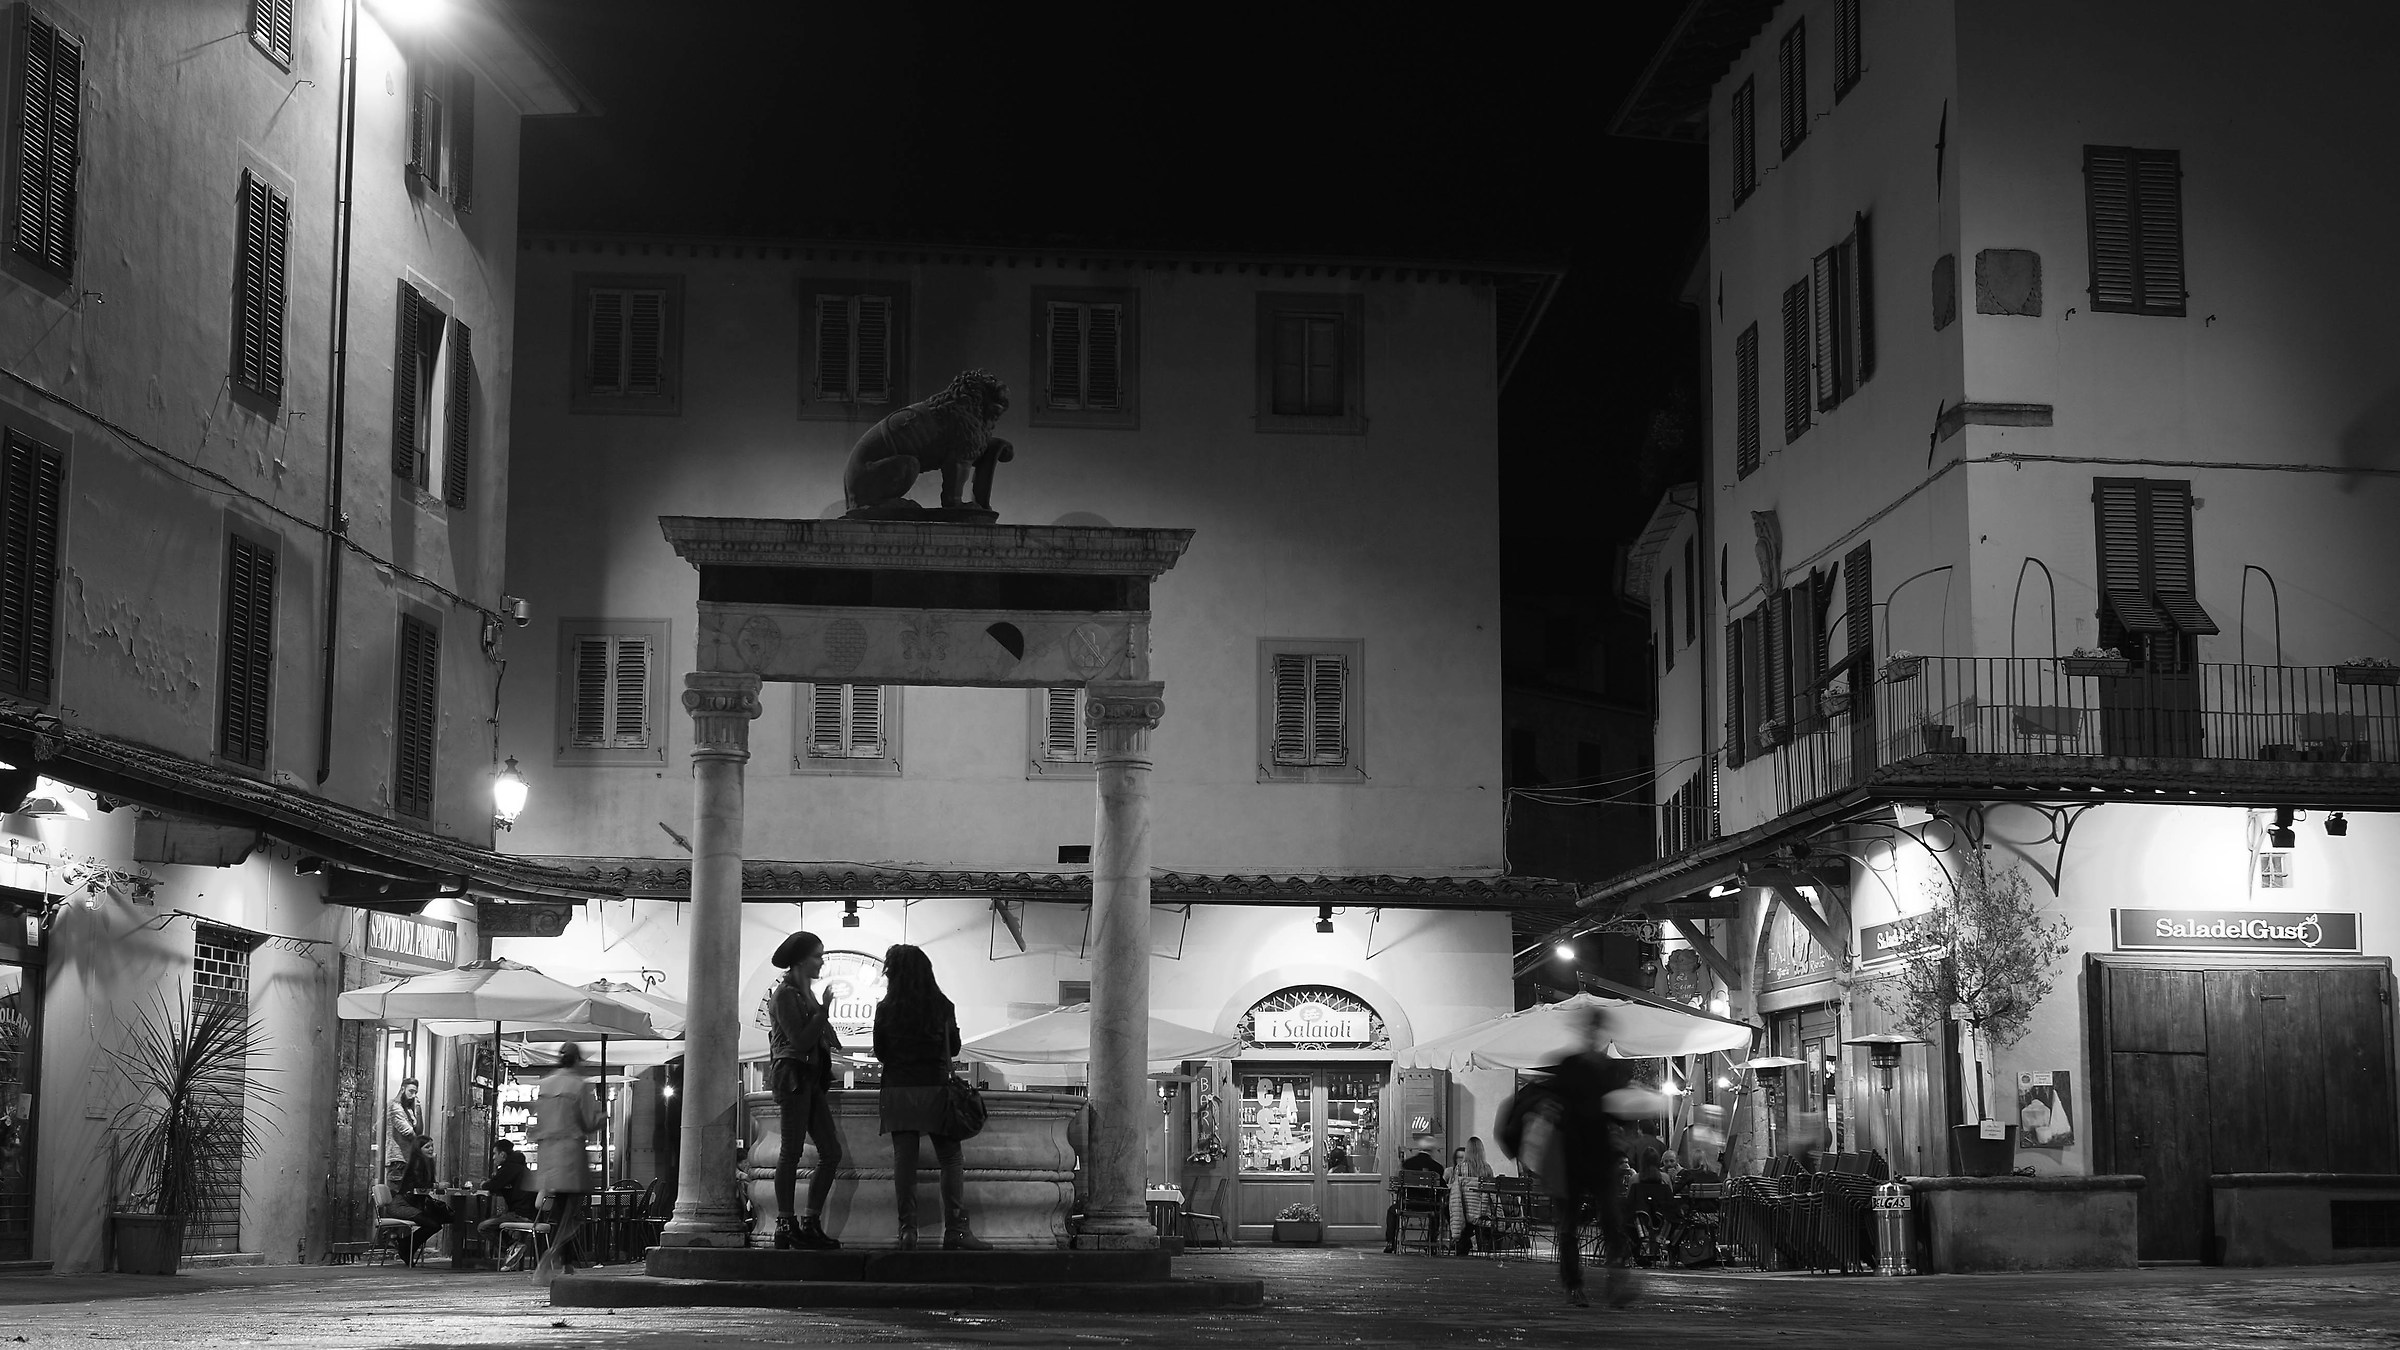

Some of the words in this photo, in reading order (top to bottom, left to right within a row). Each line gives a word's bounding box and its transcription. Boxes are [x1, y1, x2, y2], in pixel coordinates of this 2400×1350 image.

[400, 919, 415, 956] DEL
[1272, 1020, 1277, 1038] i
[1283, 1019, 1352, 1038] Salaioli
[1411, 1115, 1430, 1132] illy
